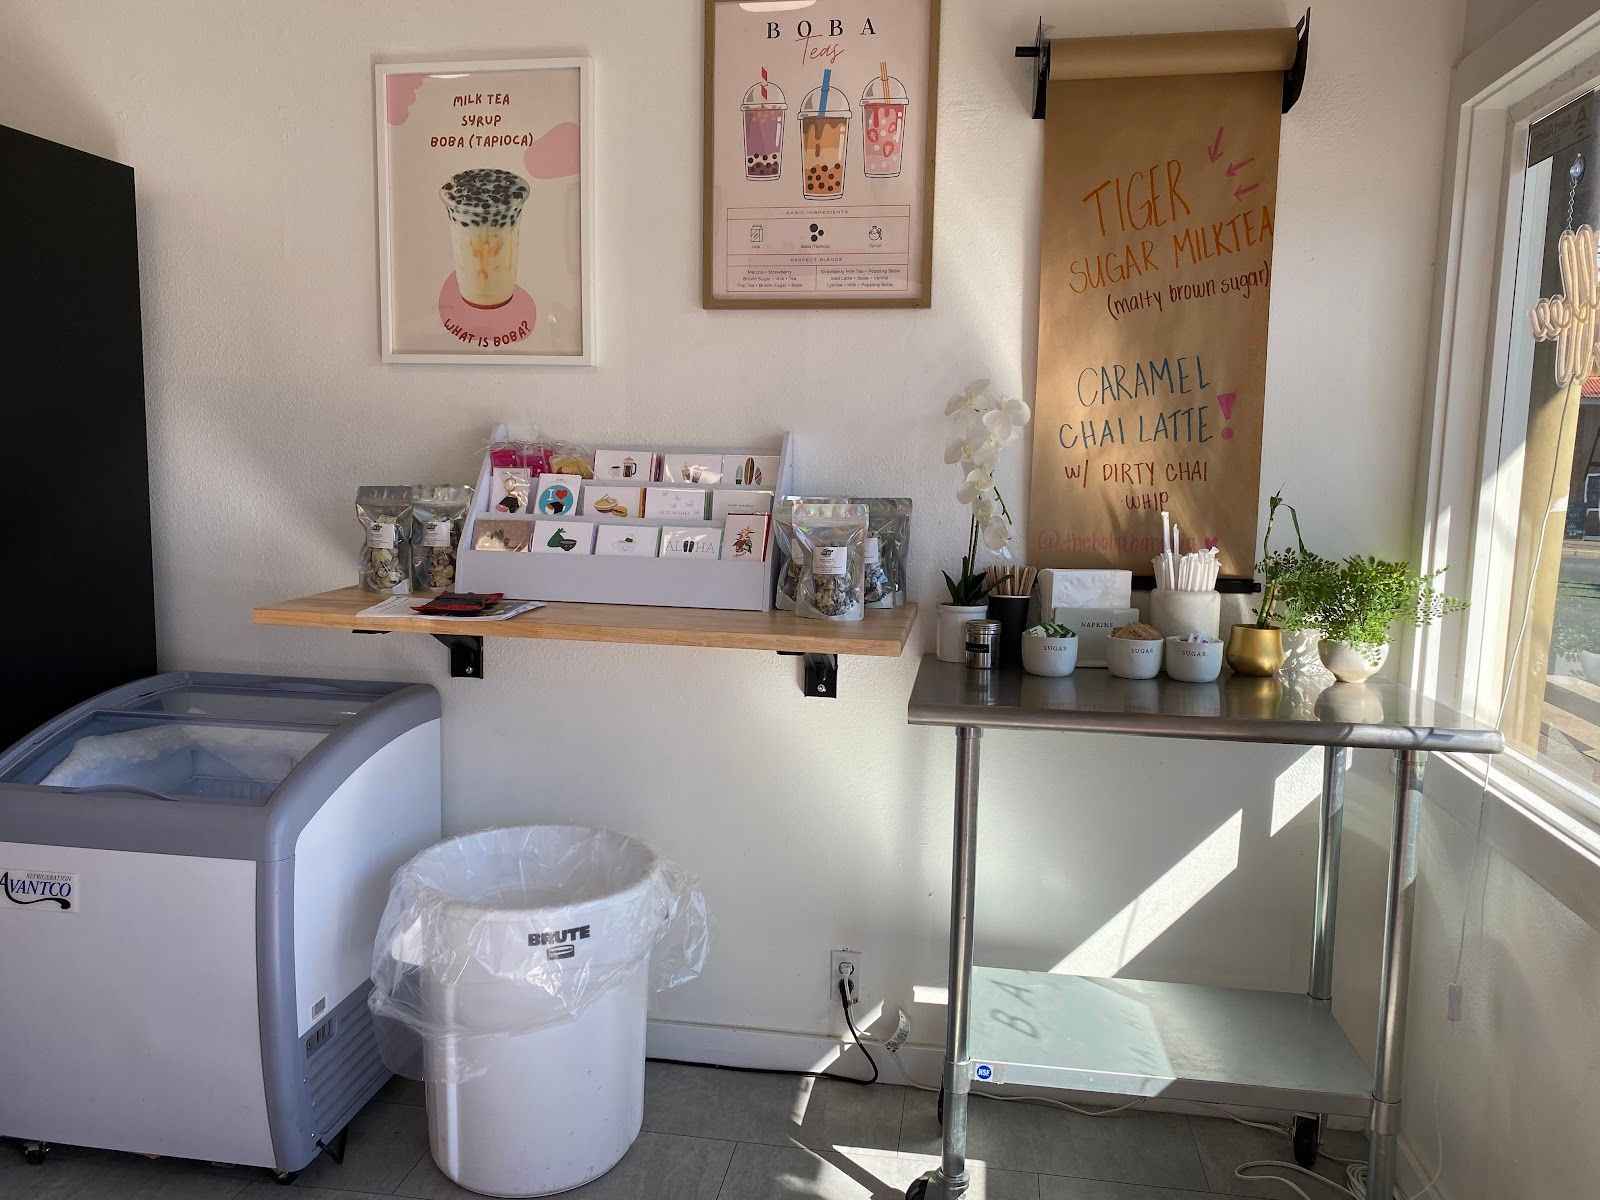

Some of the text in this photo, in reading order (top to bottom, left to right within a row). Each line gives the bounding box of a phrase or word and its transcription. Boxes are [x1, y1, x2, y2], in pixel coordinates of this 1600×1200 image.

[766, 18, 877, 39] BOBA
[453, 93, 510, 106] MILK TEA
[461, 114, 502, 127] SYRUP
[430, 132, 534, 148] BOBA (TAPIOCA)
[1082, 159, 1191, 236] TIGER
[1069, 205, 1274, 293] SUGAR MILKTEA
[1107, 260, 1270, 320] (malty brown sugar)
[444, 318, 530, 348] WHAT IS BOBA?
[1077, 356, 1211, 407] CARAMEL
[1059, 417, 1125, 449] CHAI
[1103, 462, 1155, 486] DIRTY
[1166, 460, 1208, 482] CHAI
[1125, 492, 1169, 512] WHIP
[26, 873, 72, 881] REFRIGERATION
[528, 924, 590, 946] BRUTE
[977, 1067, 992, 1077] NSF
